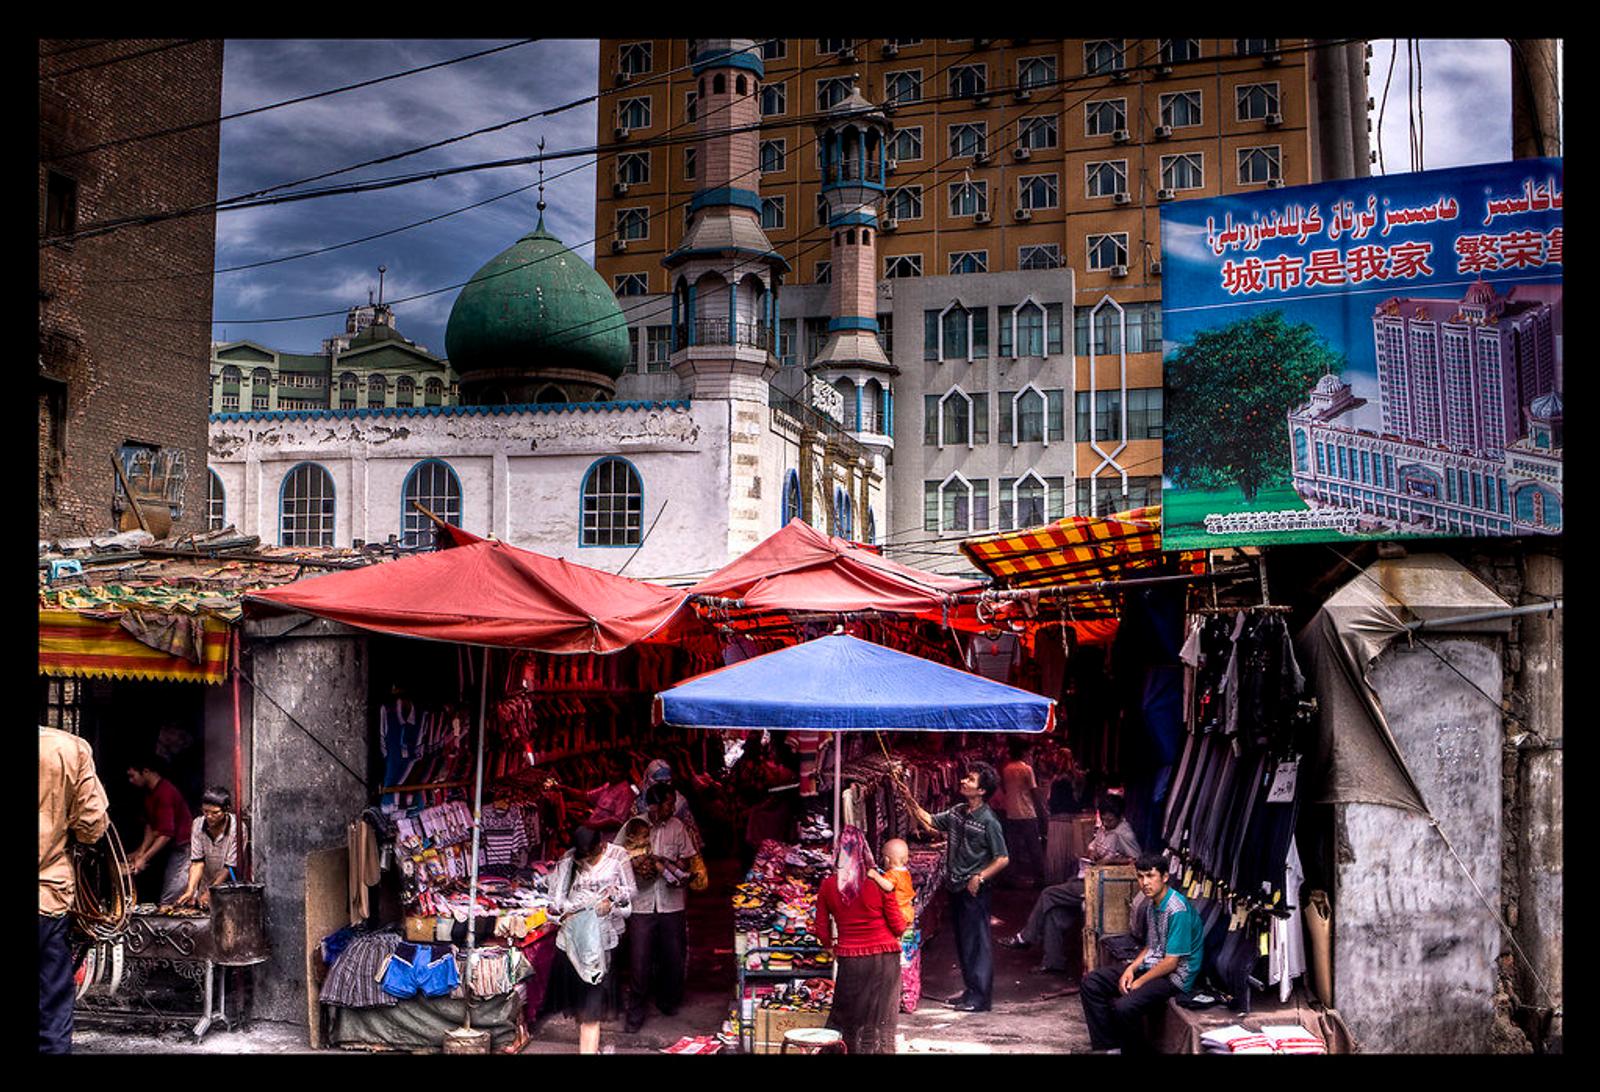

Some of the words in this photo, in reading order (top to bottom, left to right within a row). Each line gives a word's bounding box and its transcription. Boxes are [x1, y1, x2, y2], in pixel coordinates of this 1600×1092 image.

[1221, 241, 1434, 295] 城市是我家
